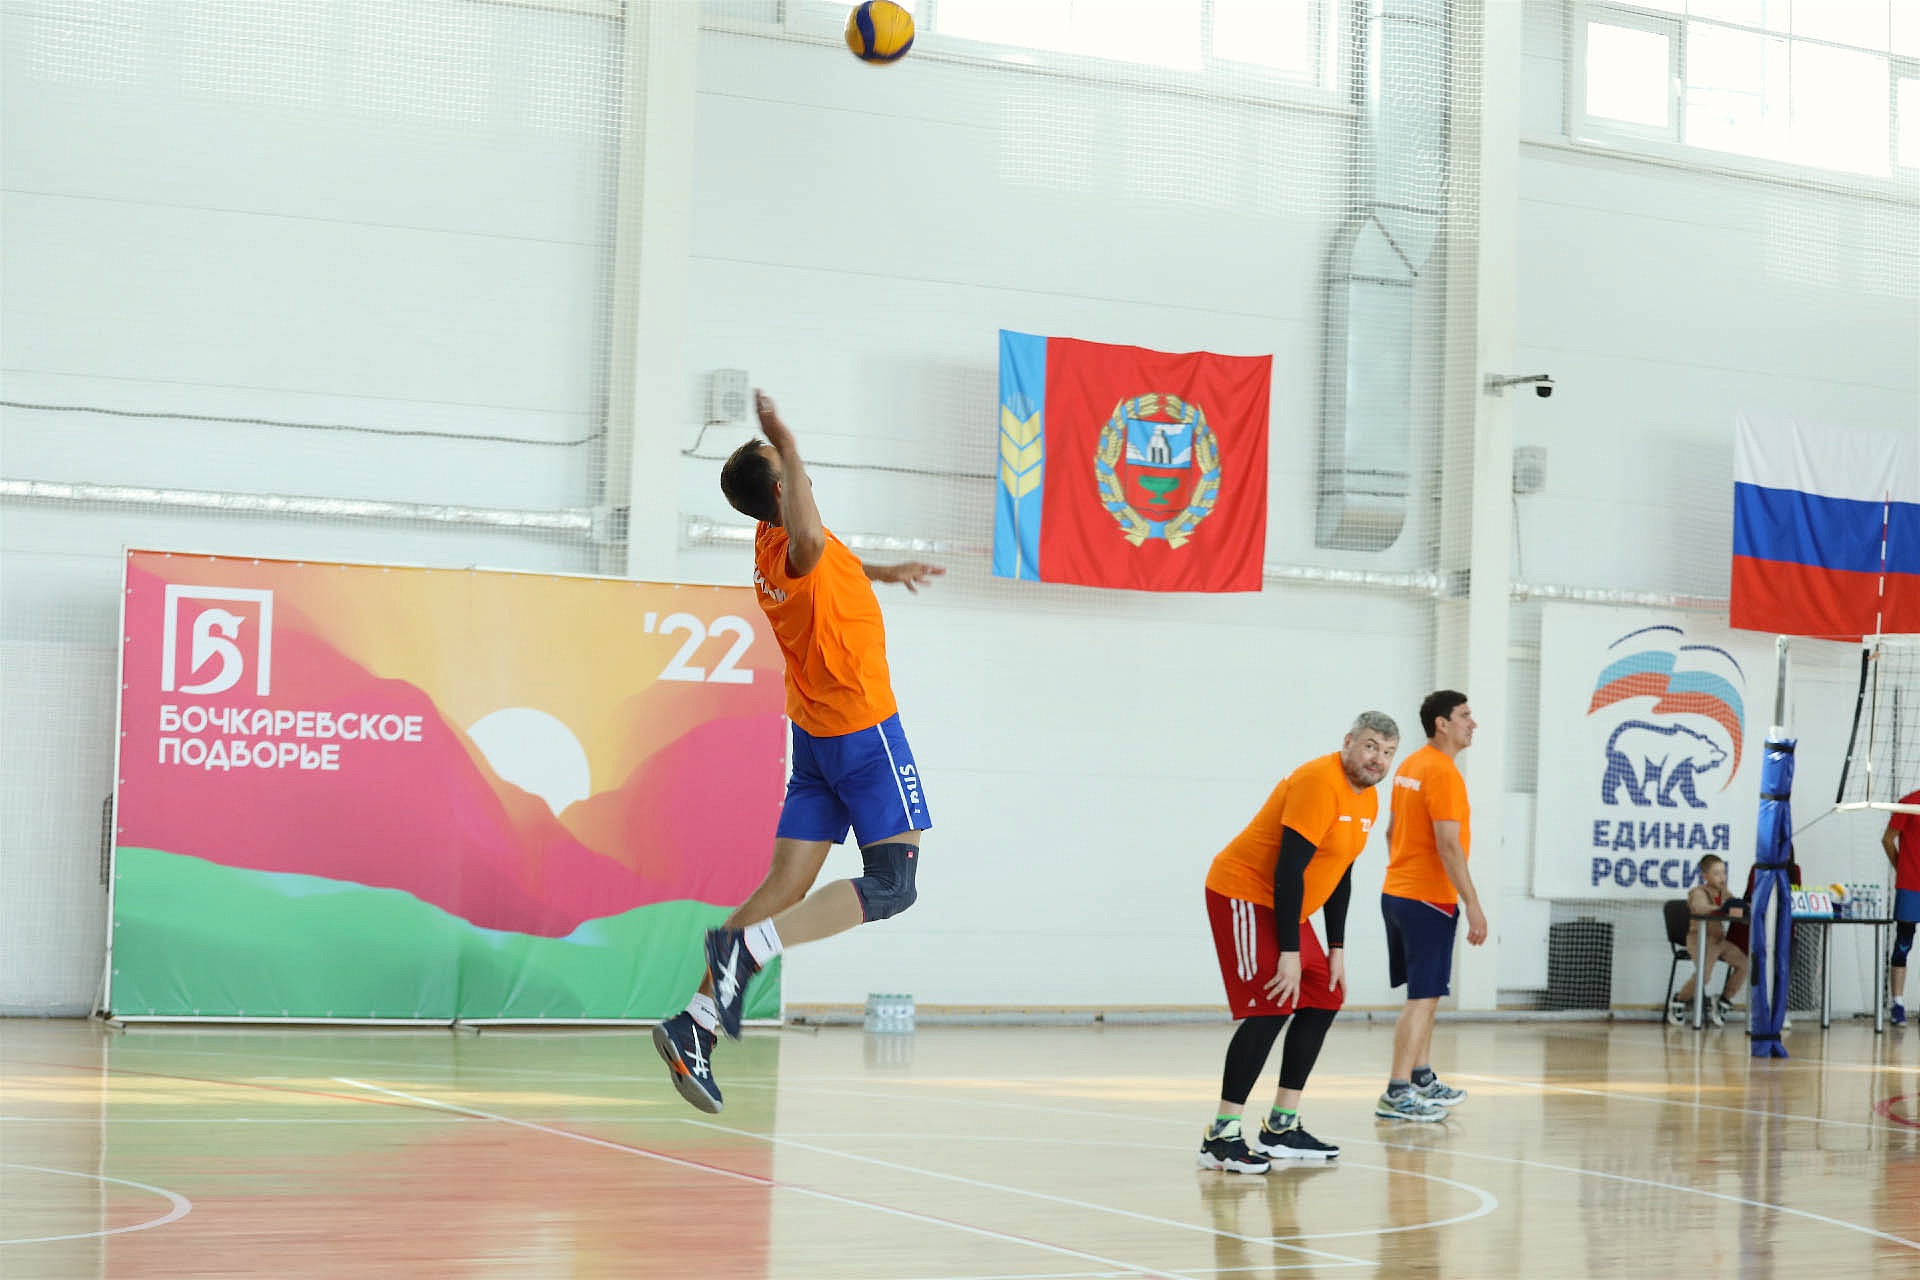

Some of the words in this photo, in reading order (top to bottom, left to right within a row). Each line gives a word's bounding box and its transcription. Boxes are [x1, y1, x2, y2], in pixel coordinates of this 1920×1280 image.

[159, 704, 423, 742] БОЧКАРЕВСКОЕ
[158, 737, 341, 771] ПОДВОРЬЕ
[1592, 819, 1730, 851] ЕДИНАЯ
[1592, 857, 1729, 888] РОССИ
